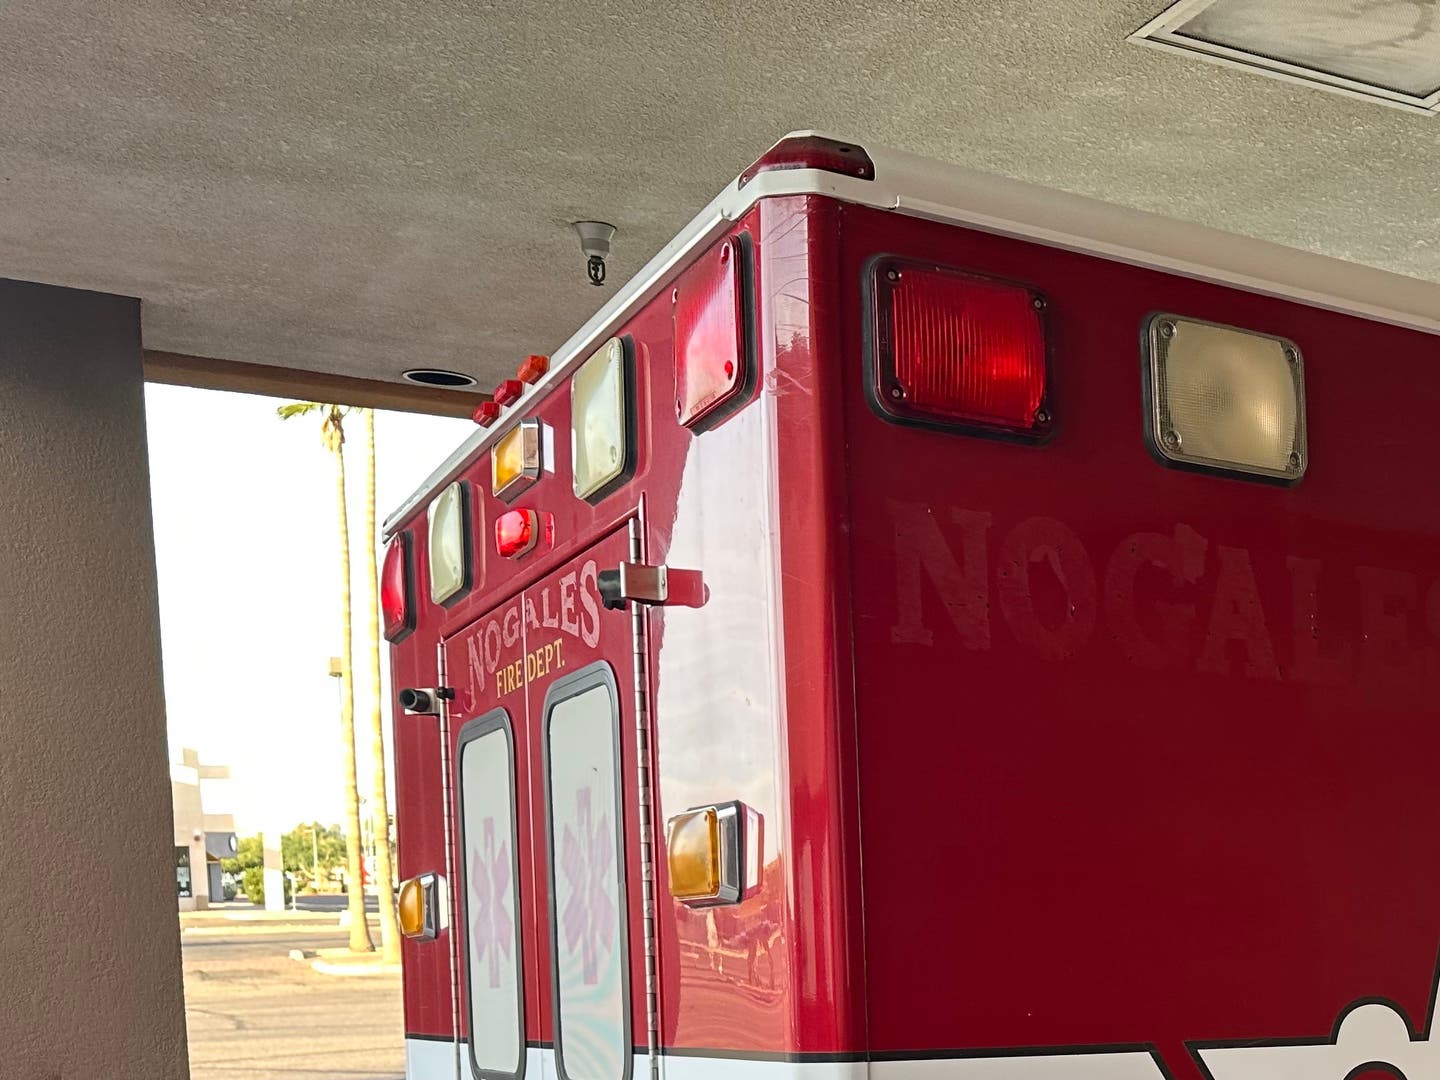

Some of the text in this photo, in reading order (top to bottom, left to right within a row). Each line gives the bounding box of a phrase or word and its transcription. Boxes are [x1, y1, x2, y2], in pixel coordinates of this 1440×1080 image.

[464, 560, 600, 712] NOGALES
[495, 638, 566, 699] FIRE DEPT.
